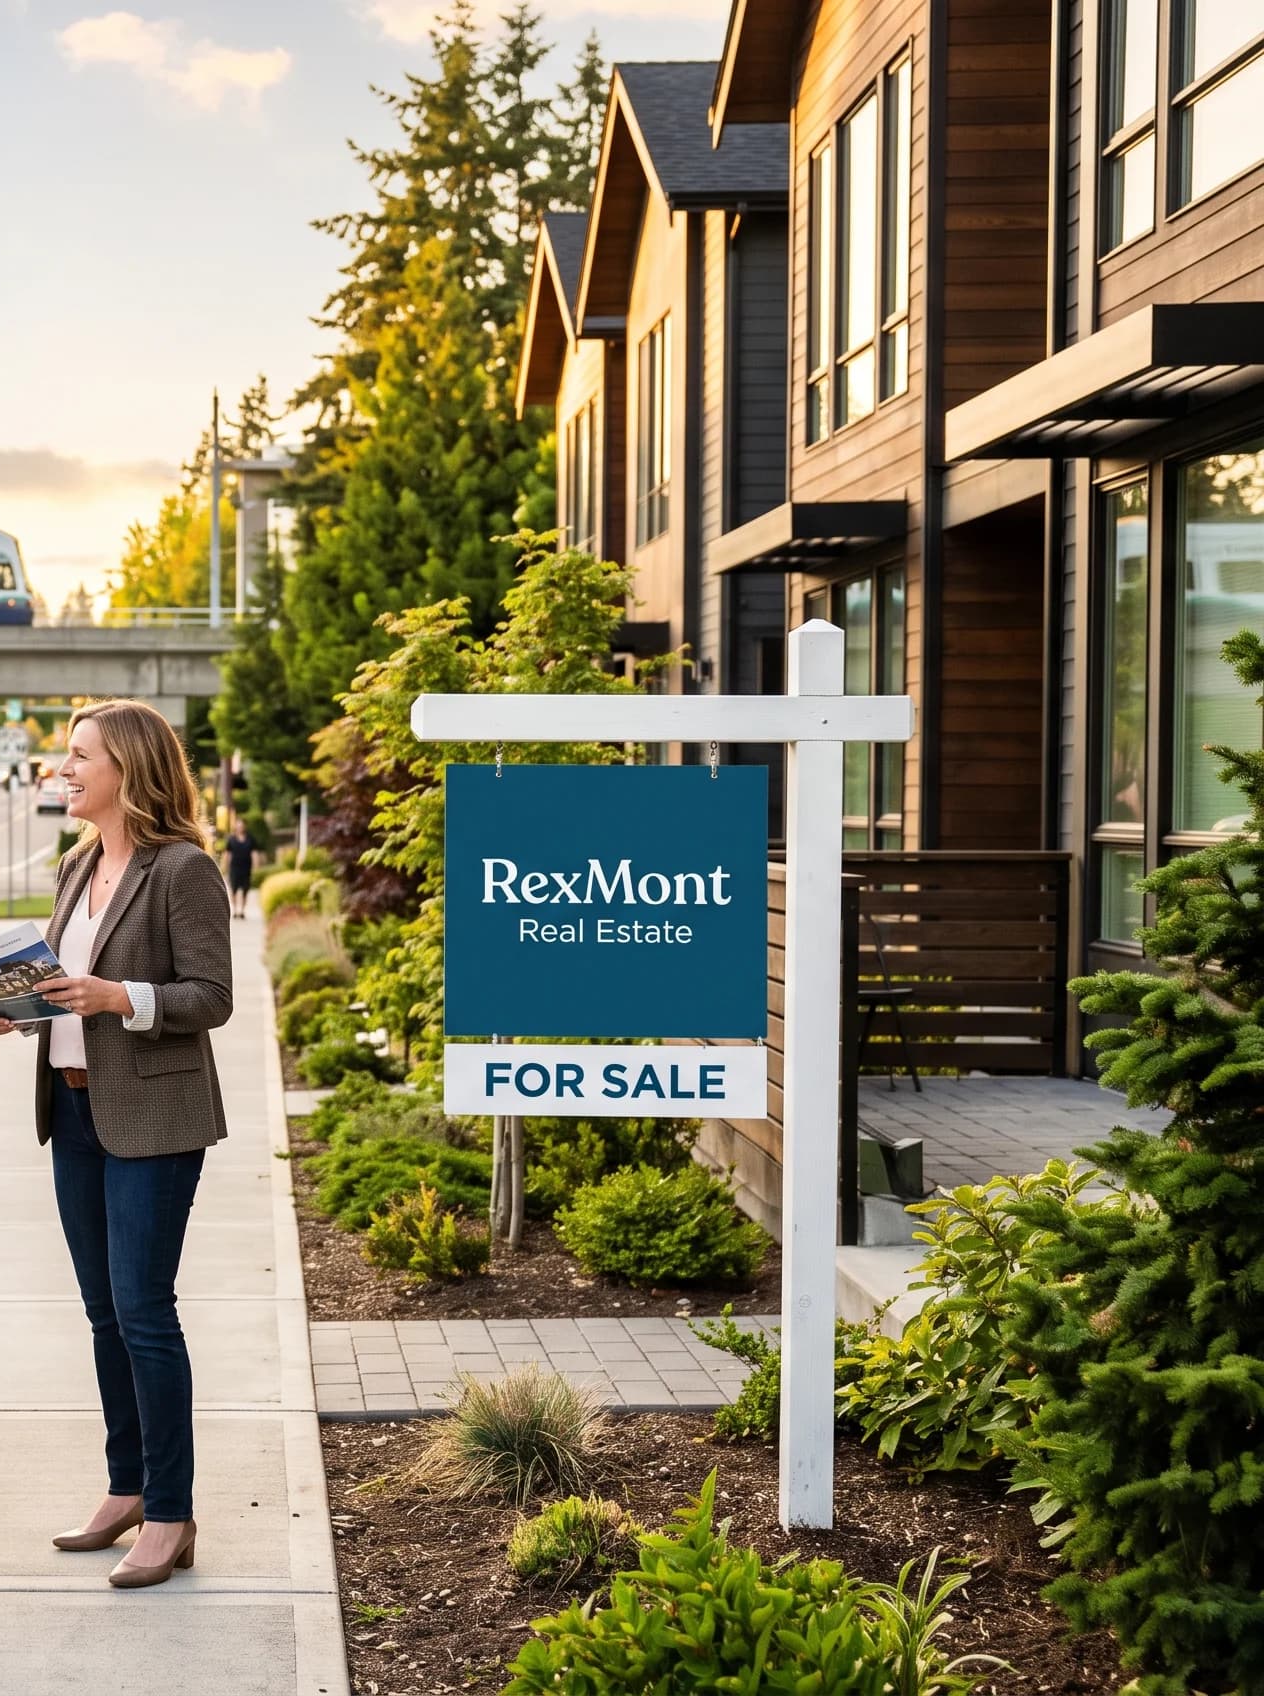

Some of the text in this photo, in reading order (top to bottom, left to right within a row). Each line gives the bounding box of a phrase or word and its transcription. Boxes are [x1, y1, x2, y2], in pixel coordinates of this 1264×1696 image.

[481, 858, 732, 906] RexMont
[519, 918, 693, 944] Real Estate
[485, 1062, 726, 1100] FOR SALE
